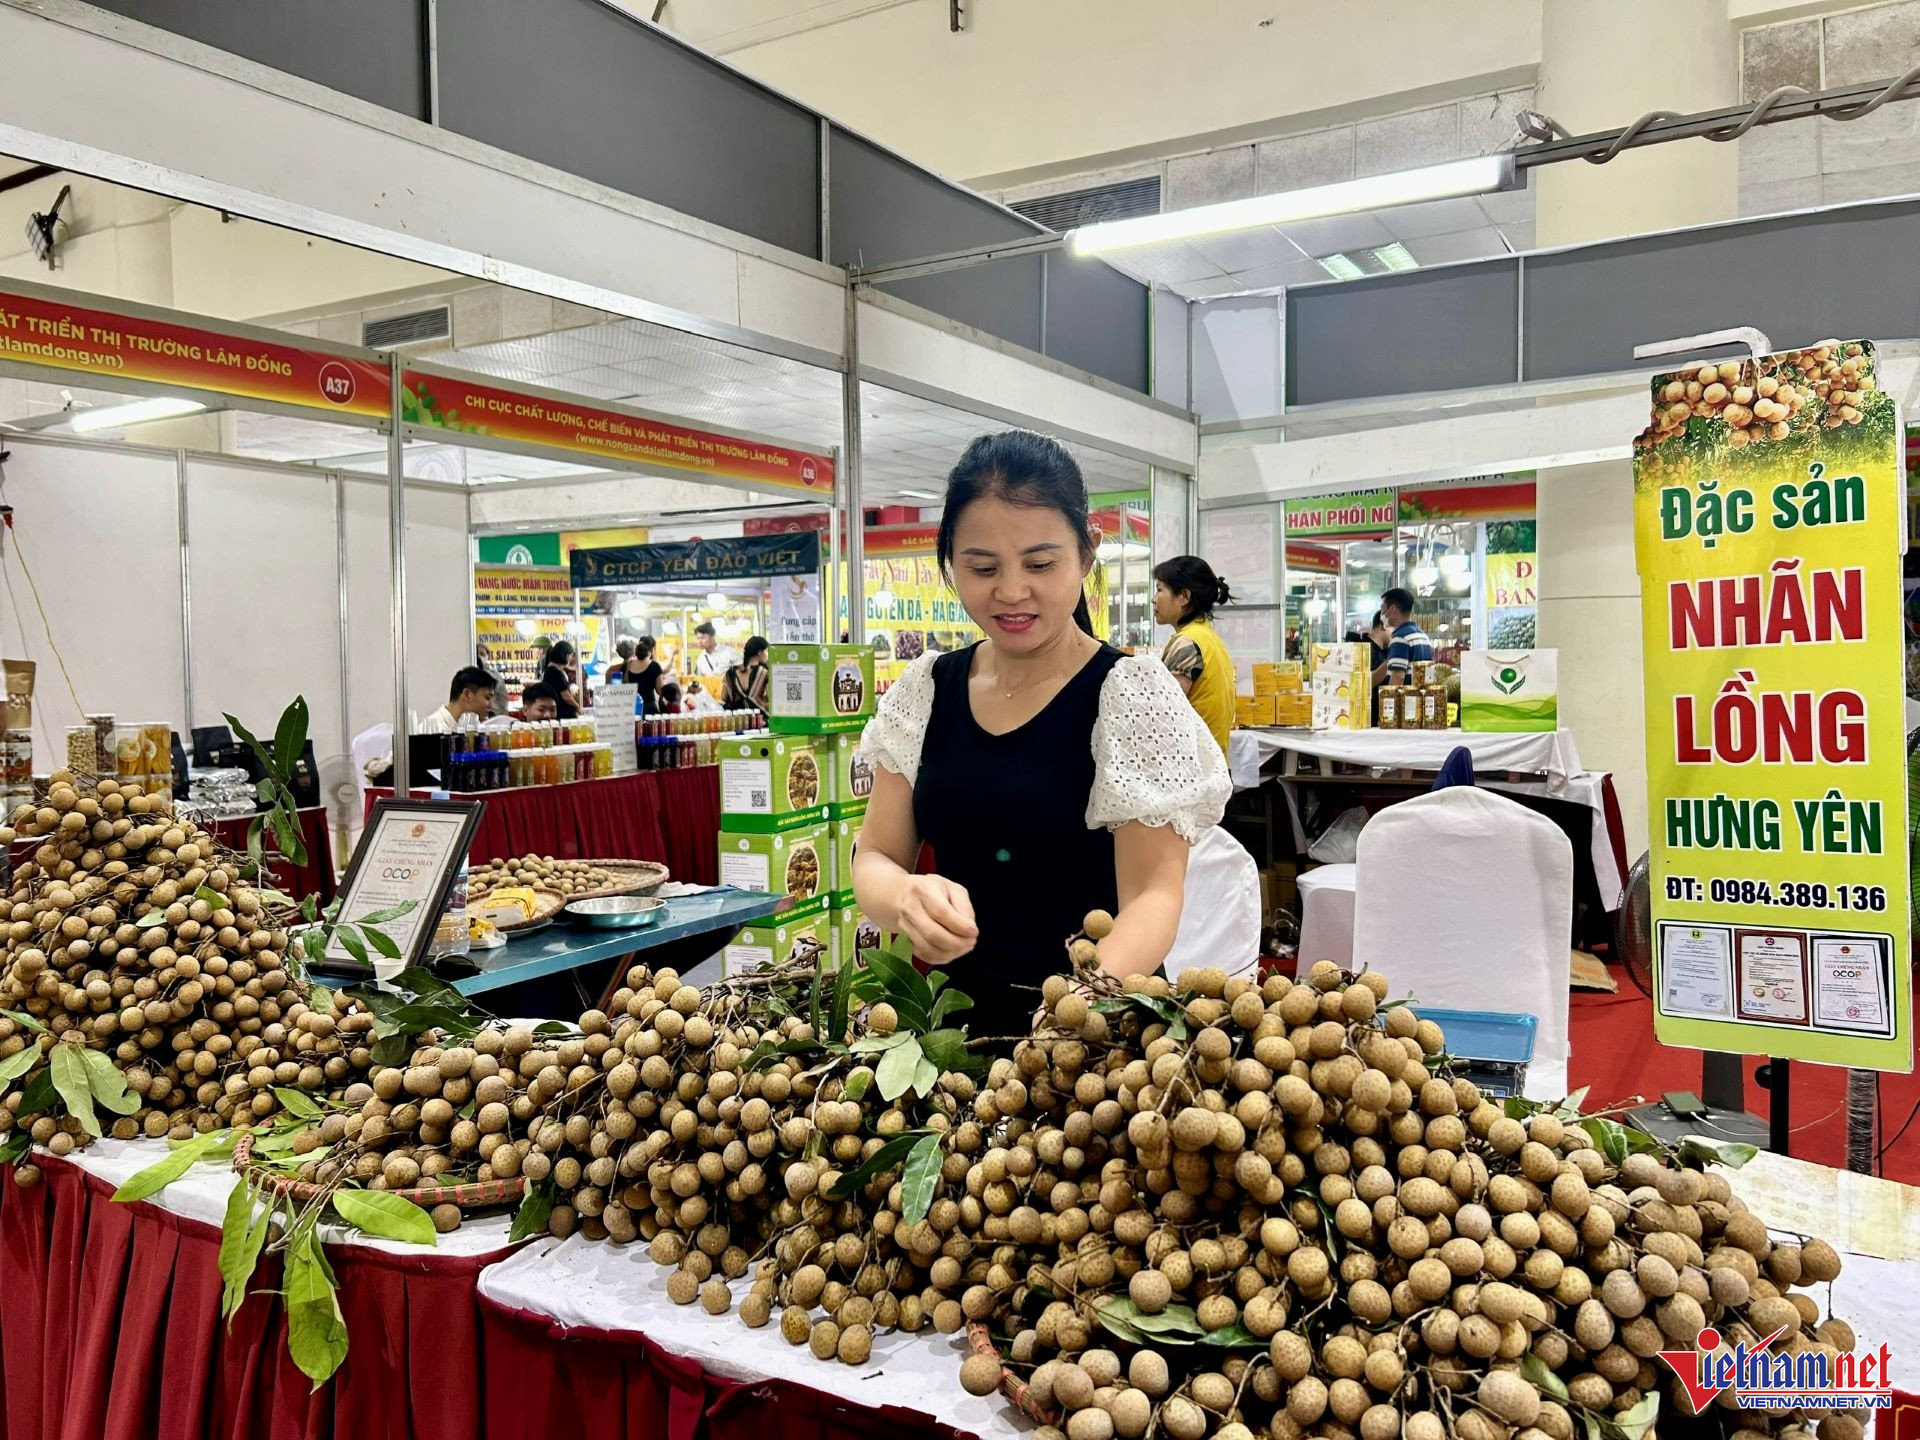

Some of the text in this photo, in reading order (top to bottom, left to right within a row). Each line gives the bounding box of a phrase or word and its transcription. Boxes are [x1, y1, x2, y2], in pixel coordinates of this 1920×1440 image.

[26, 315, 85, 340] TRIỂN
[90, 327, 121, 350] THỊ
[126, 334, 201, 360] TRƯỜNG
[206, 347, 241, 368] LÂM
[325, 376, 351, 395] A37
[465, 395, 486, 409] CHI
[488, 399, 512, 414] CỤC
[515, 403, 544, 419] CHẤT
[546, 410, 586, 430] LƯỢNG,
[588, 417, 608, 432] CHẾ
[610, 421, 632, 437] BIẾN
[633, 427, 647, 440] VÀ
[648, 431, 671, 444] PHÁT
[1285, 508, 1322, 529] HÂN
[1327, 502, 1366, 526] PHỐI
[1660, 463, 1865, 548] Đặc sản
[603, 560, 653, 577] CTCP
[907, 595, 922, 621] ĐÁ
[1670, 558, 1863, 649] NHÃN
[1675, 670, 1866, 764] LỒNG
[1666, 789, 1882, 854] HƯNG YÊN
[382, 867, 420, 881] OCOP
[1666, 876, 1886, 911] ĐT: 0984.389.136
[1832, 969, 1862, 978] OCOP
